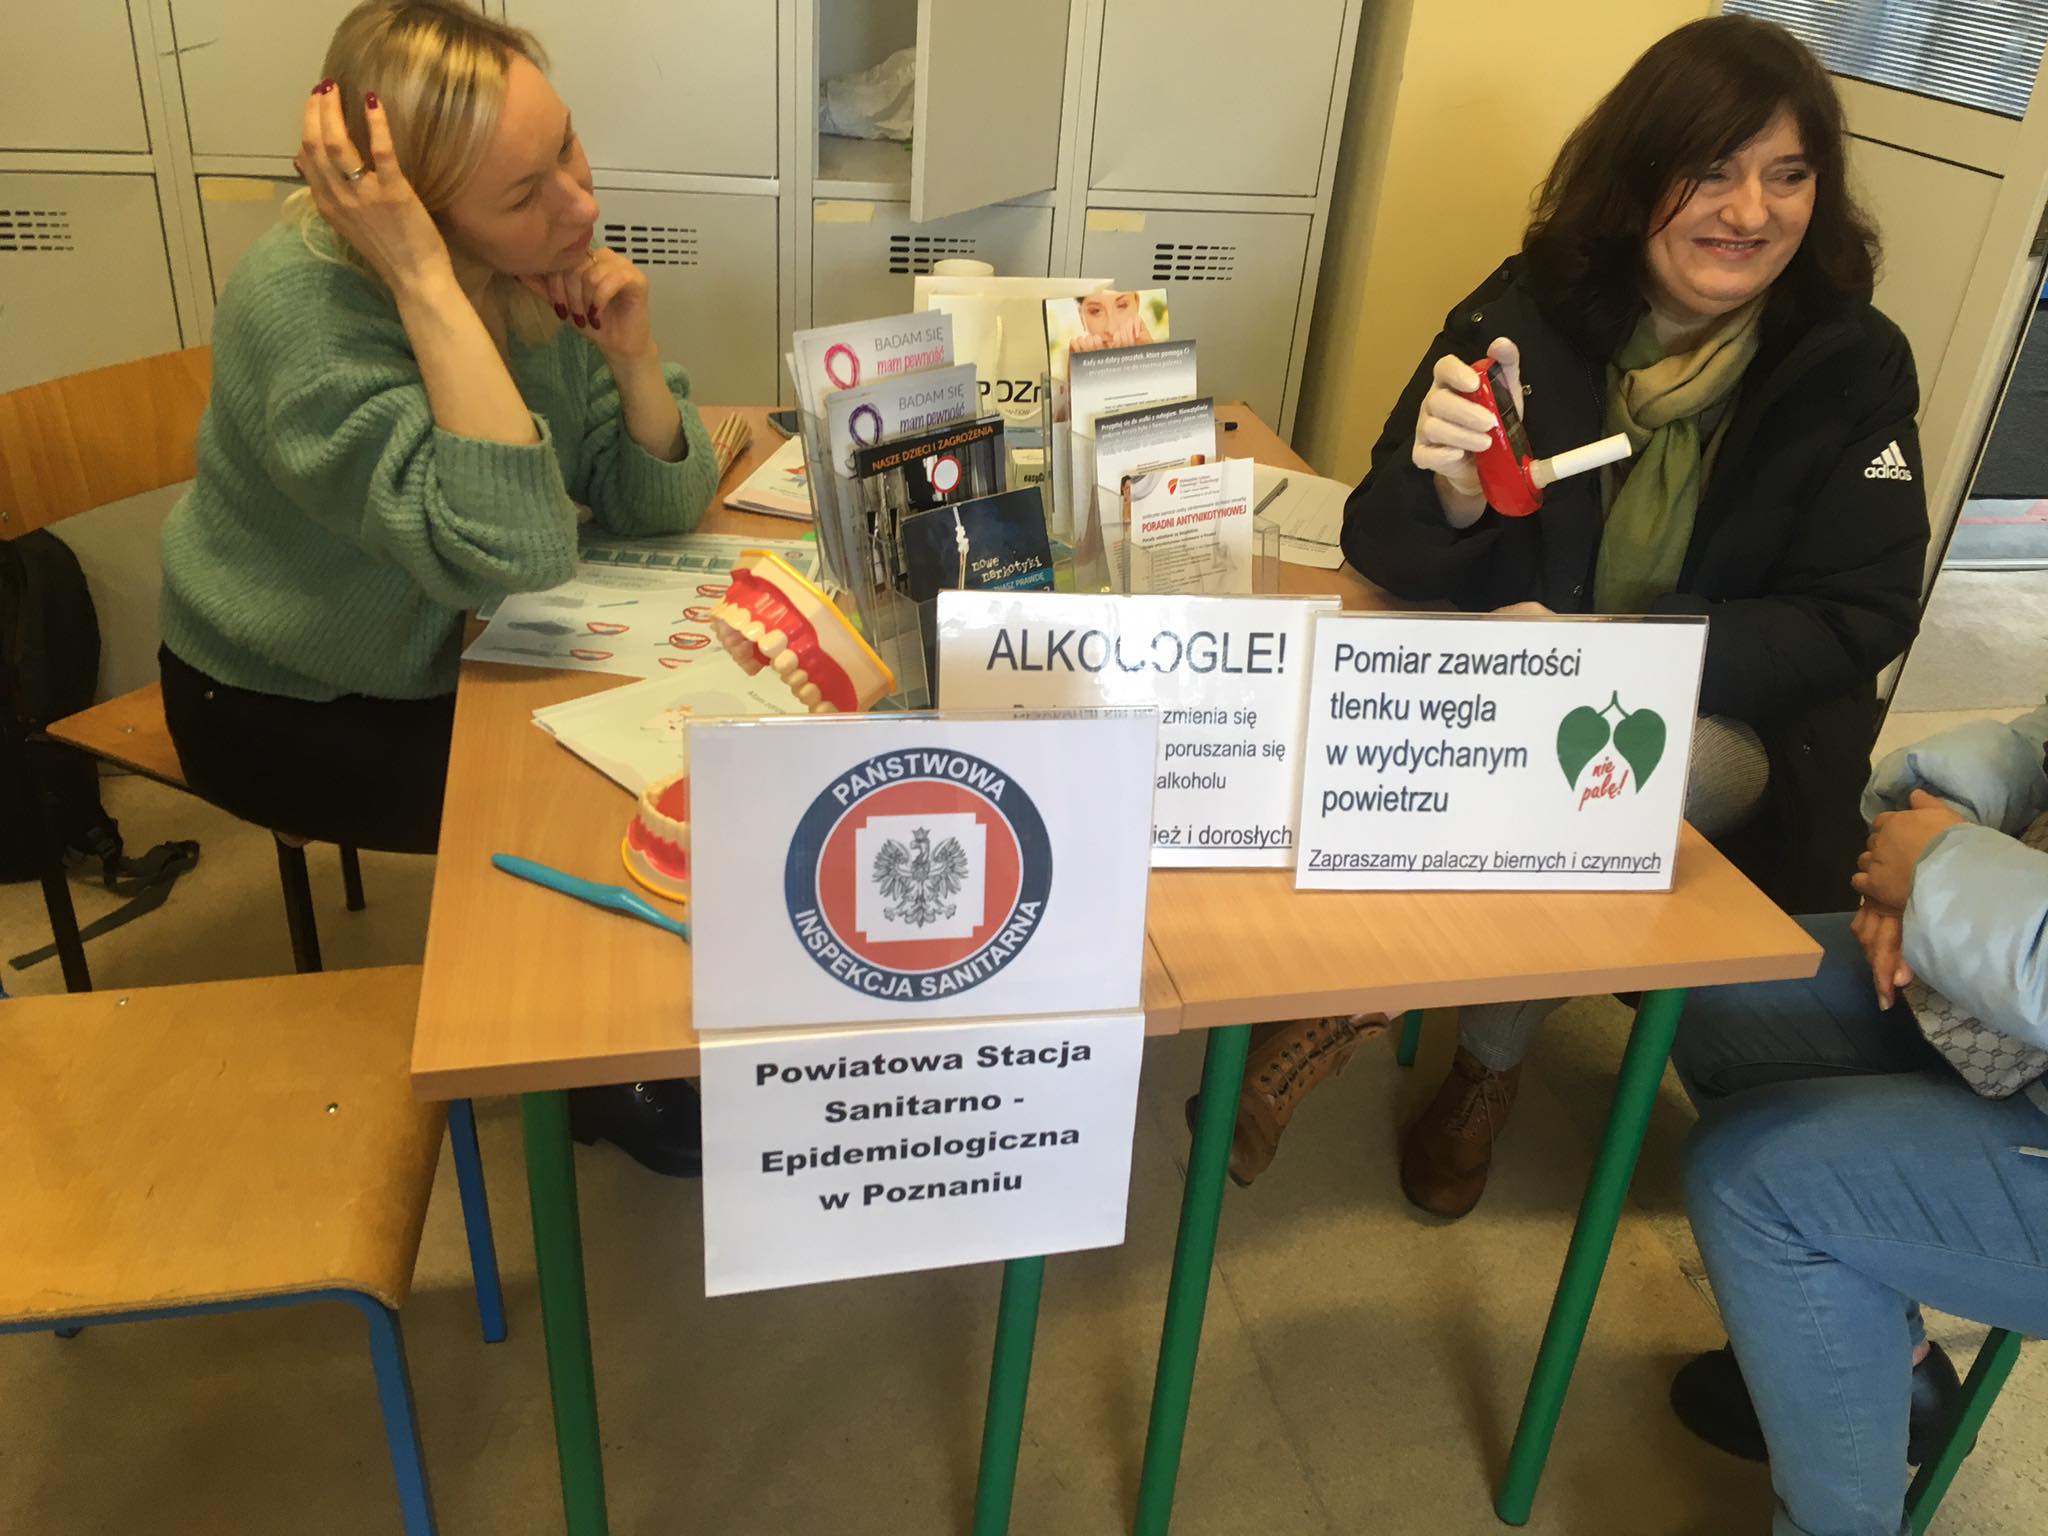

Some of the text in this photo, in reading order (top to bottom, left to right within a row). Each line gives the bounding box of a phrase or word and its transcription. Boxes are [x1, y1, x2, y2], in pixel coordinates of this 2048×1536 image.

[875, 327, 943, 352] BADAM SIĘ
[877, 348, 945, 376] mam pewność
[899, 383, 966, 410] BADAM SIĘ
[900, 415, 925, 434] mam
[926, 404, 966, 428] pewność
[872, 453, 900, 471] NASZE
[902, 443, 931, 461] DZIECI
[938, 425, 994, 450] ZAGROŻENIA
[1864, 465, 1912, 481] adidas
[1142, 519, 1174, 534] PORADNI
[1176, 504, 1247, 526] ANTYNIKOTYNOWEJ
[971, 557, 1000, 572] nowe
[981, 555, 1042, 582] narkotyki
[1334, 643, 1582, 676] Pomiar zawartości
[1162, 708, 1229, 725] zmienia
[1233, 707, 1257, 729] się
[1330, 692, 1496, 729] tlenku węgla
[1165, 740, 1286, 761] poruszania się
[1326, 740, 1528, 774] w wydychanym
[833, 752, 1006, 806] PAŃSTWOWA
[1157, 773, 1226, 790] alkoholu
[1592, 756, 1615, 777] nie
[1322, 785, 1448, 817] powietrzu
[1578, 769, 1628, 812] palę!
[1199, 826, 1292, 849] dorosłych
[1308, 849, 1417, 871] Zapraszamy
[1422, 851, 1487, 872] palaczy
[1493, 852, 1566, 872] biernych
[1581, 853, 1661, 872] czynnych
[795, 900, 1041, 997] INSPEKCJA SANITARNA
[756, 1041, 1091, 1086] Powiatowa Stacja
[825, 1093, 1002, 1123] Sanitarno
[762, 1129, 1080, 1177] Epidemiologiczna
[819, 1172, 1023, 1211] w Poznaniu
